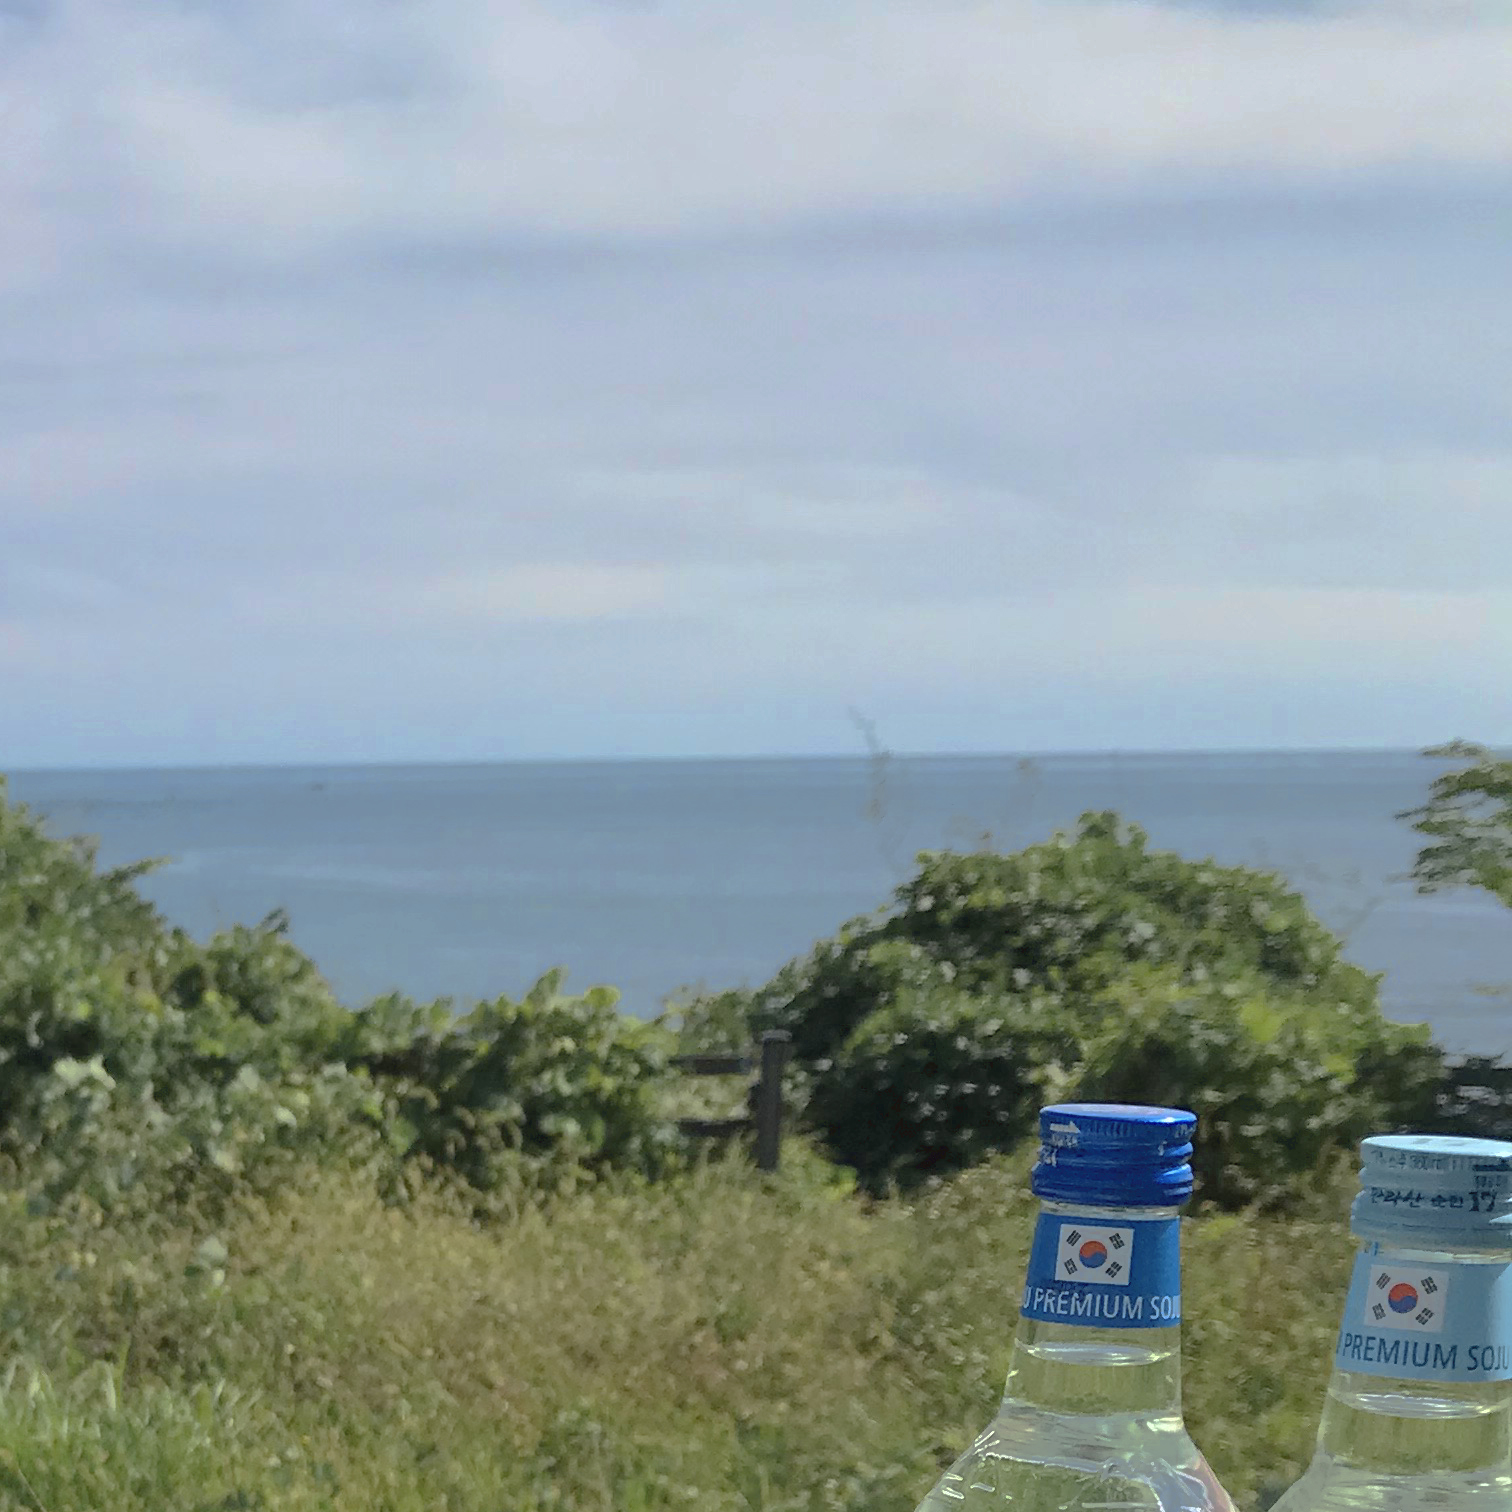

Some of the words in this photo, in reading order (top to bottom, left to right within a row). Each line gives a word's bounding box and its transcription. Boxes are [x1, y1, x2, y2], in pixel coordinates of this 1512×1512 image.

[1033, 1287, 1143, 1320] PREMIUM
[1342, 1332, 1458, 1370] PREMIUM
[1466, 1344, 1509, 1371] SOJU
